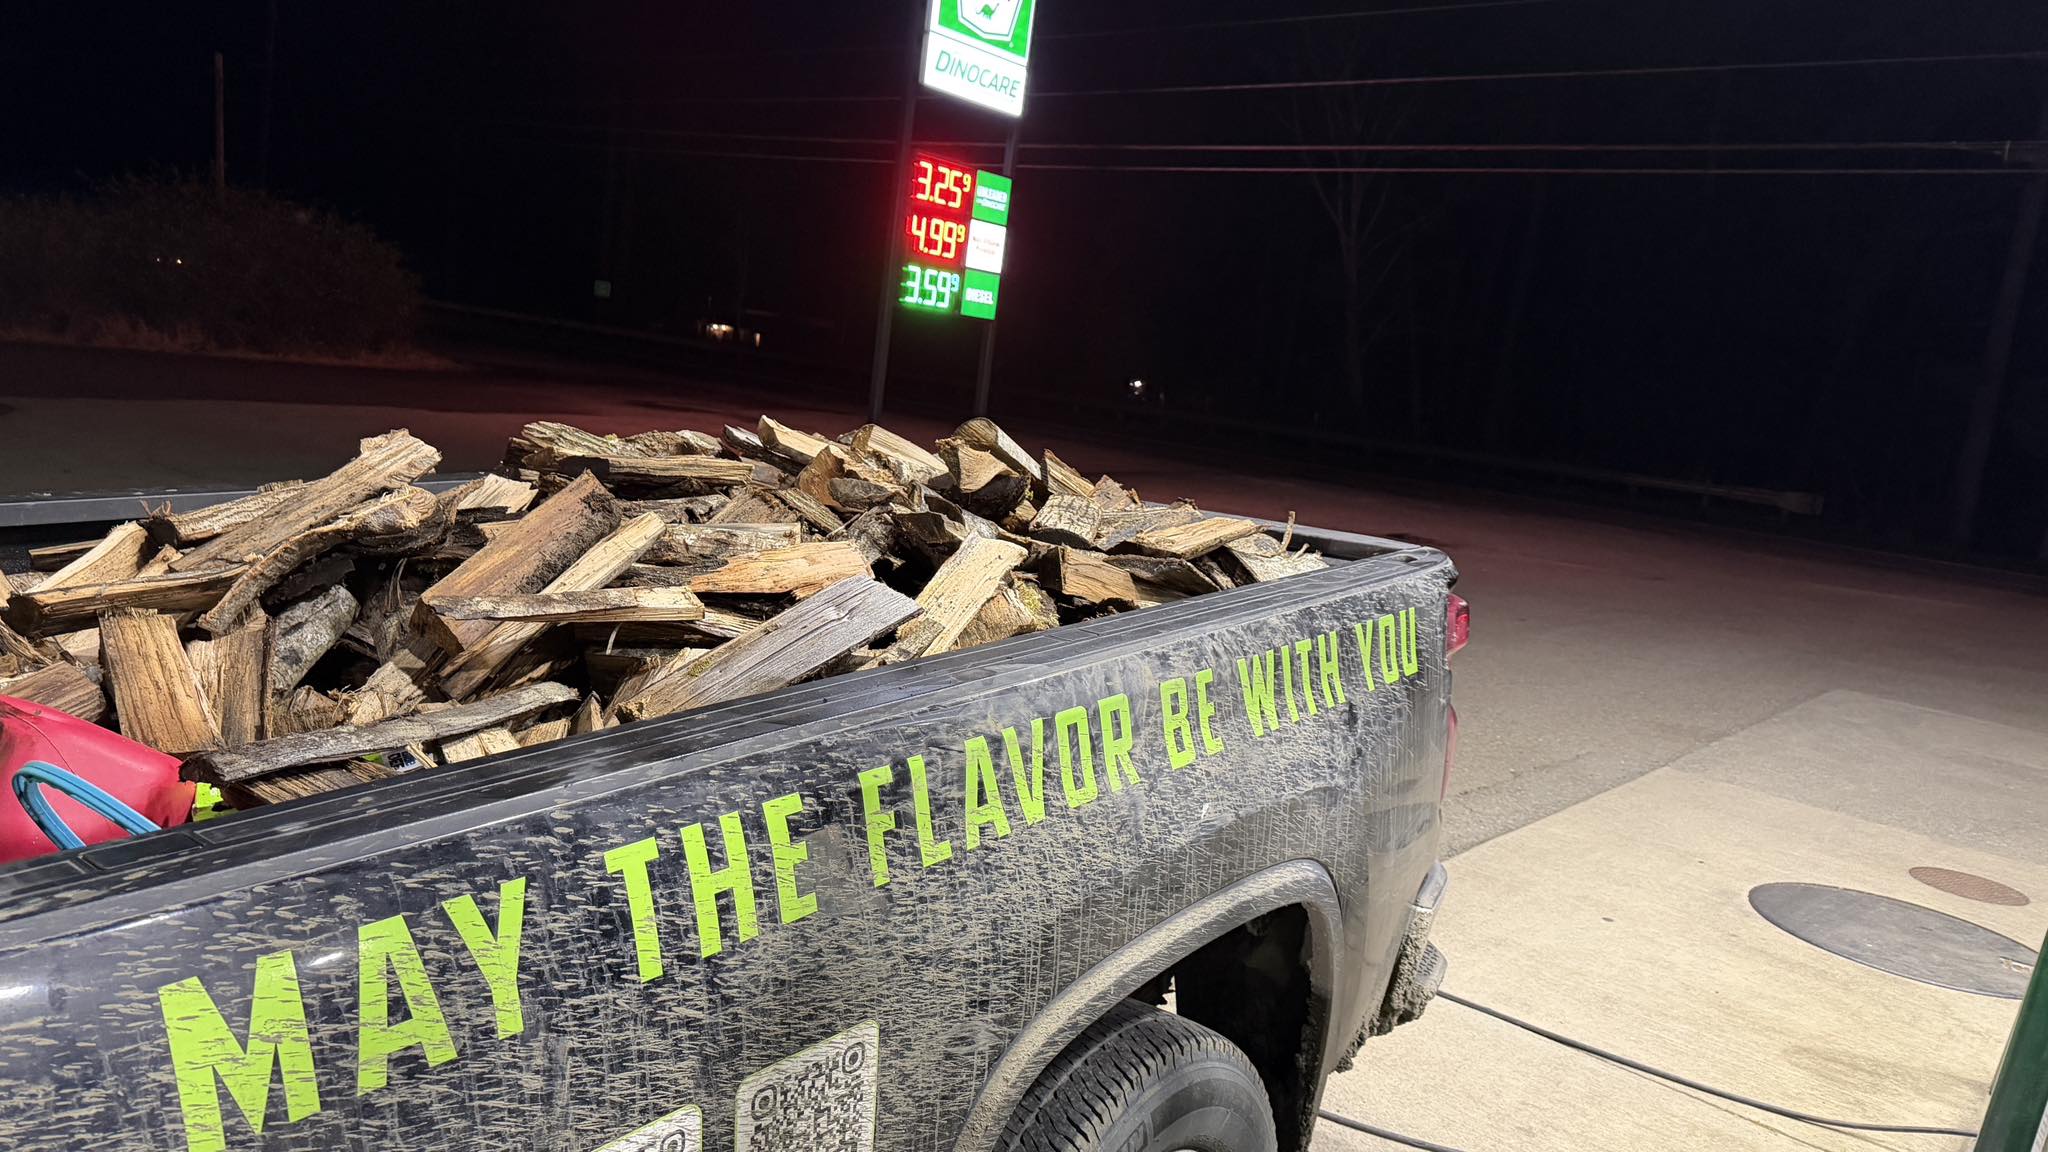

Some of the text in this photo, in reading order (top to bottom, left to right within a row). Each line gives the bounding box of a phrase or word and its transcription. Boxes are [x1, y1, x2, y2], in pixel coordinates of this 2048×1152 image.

[935, 50, 1020, 98] DINOCARE
[158, 607, 1419, 1152] MAY THE FLAVOR BE WITH YOU
